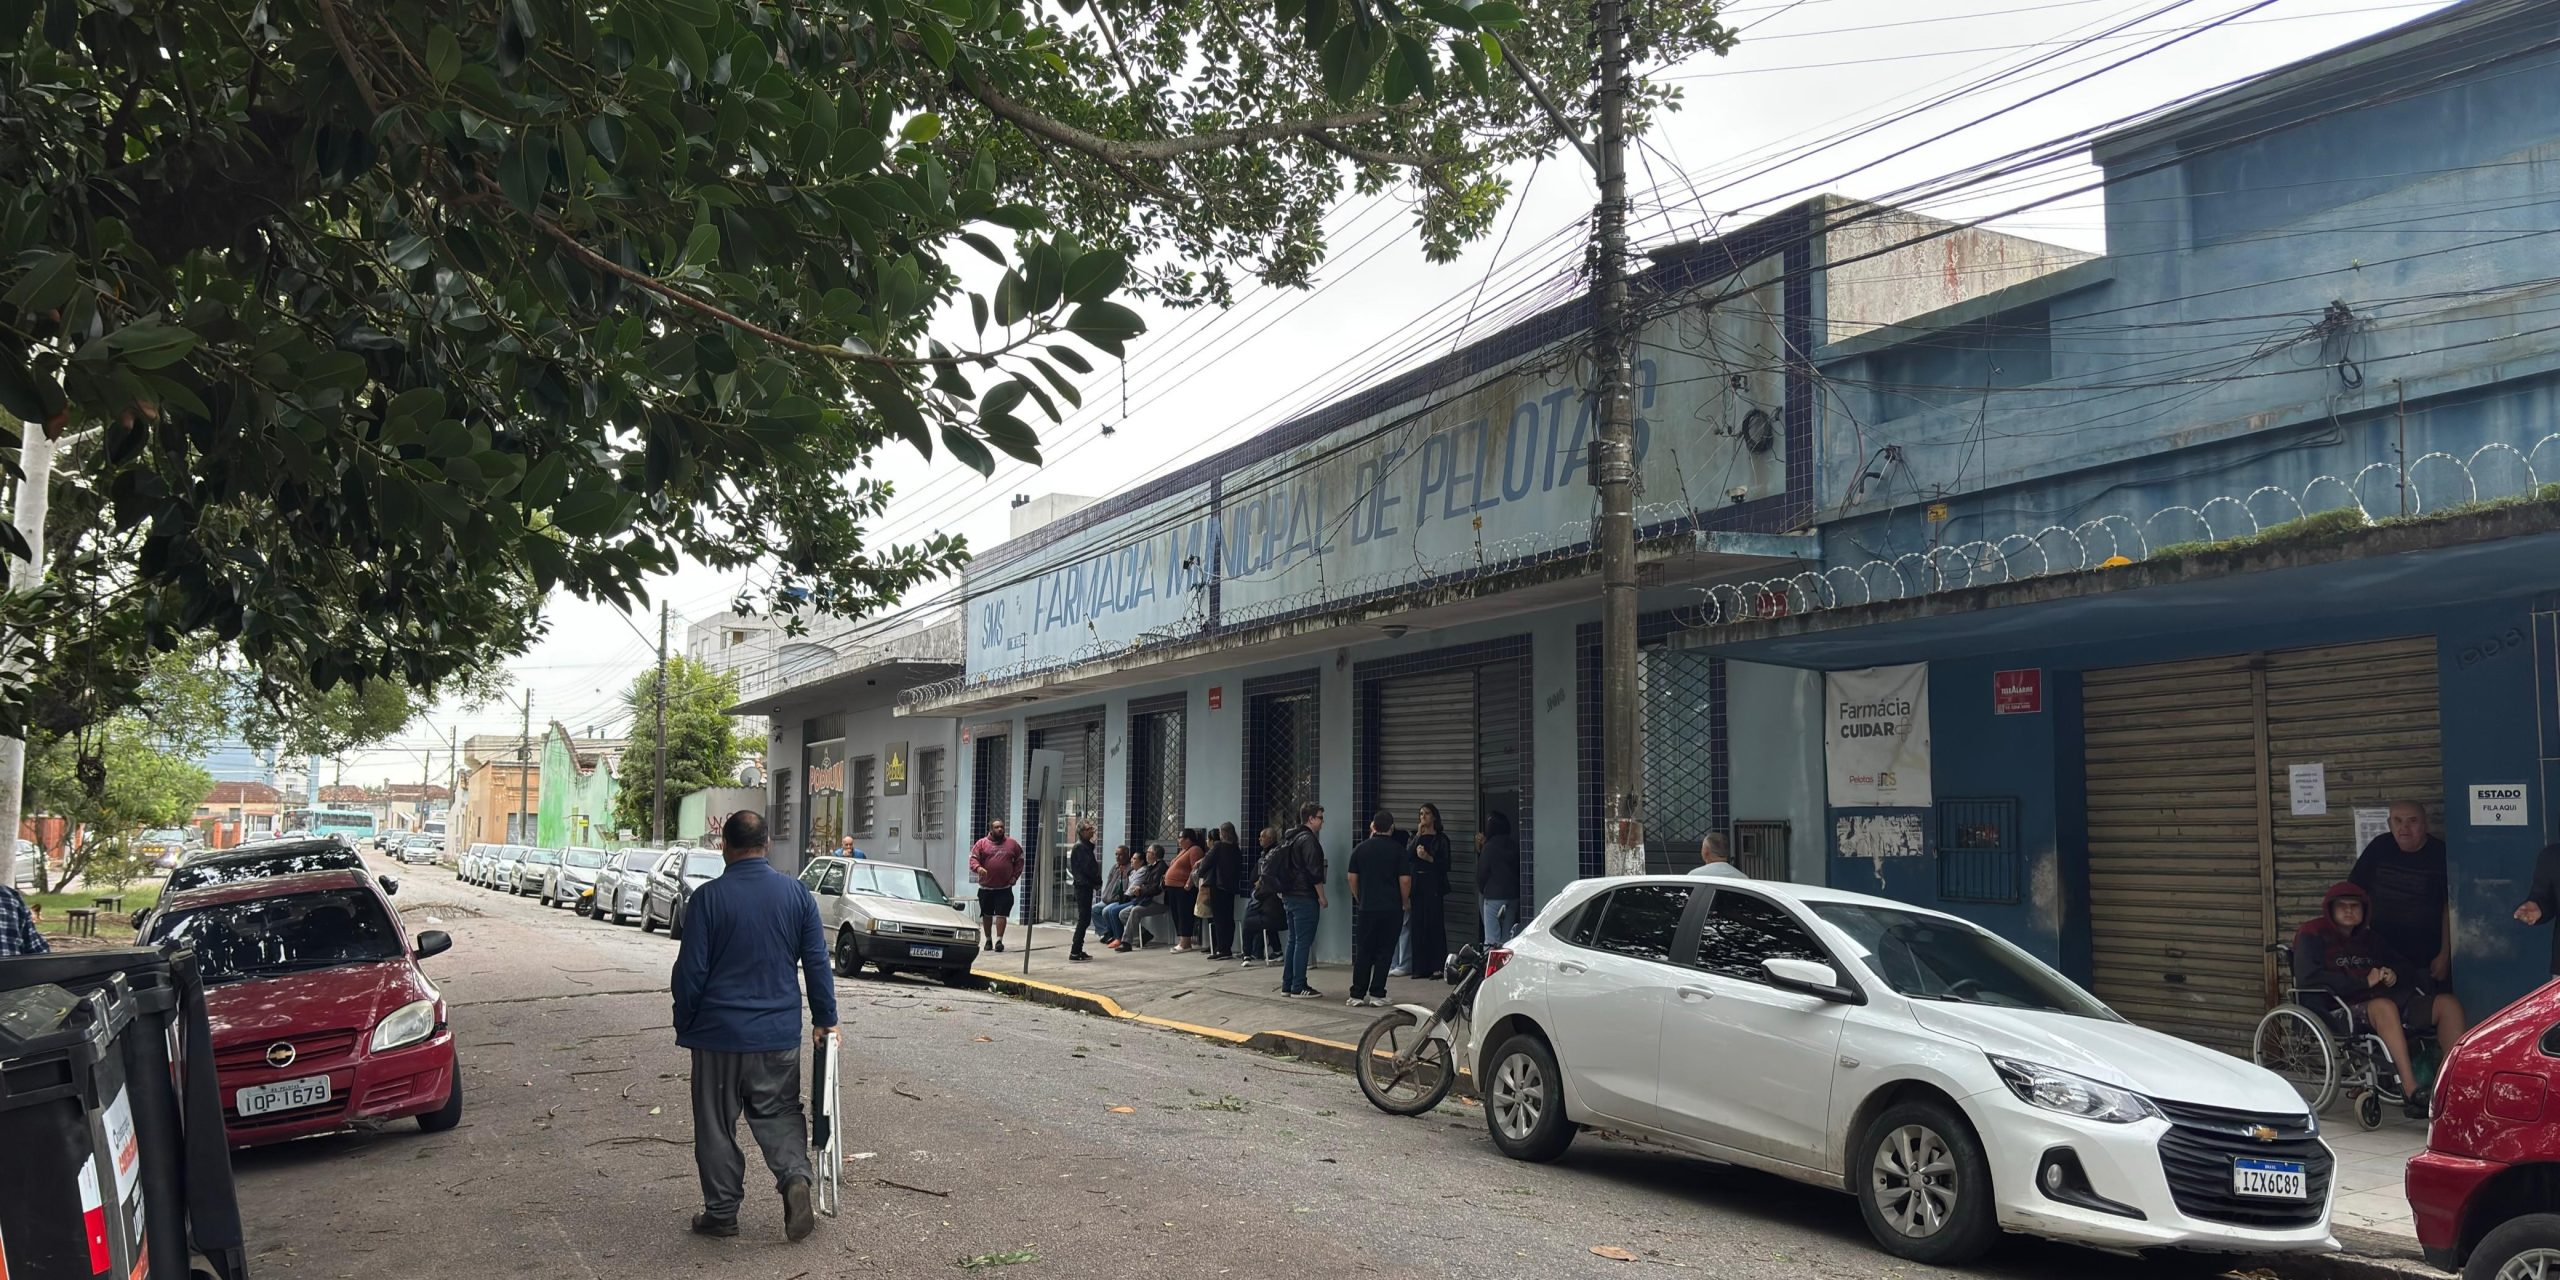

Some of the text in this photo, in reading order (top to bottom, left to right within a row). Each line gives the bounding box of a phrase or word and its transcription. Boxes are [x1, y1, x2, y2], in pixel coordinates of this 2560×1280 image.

[1166, 477, 1335, 599] MUNICIPAL
[1352, 448, 1404, 545] DE
[982, 599, 1006, 651] SMS
[1839, 697, 1911, 720] Farmácia
[1840, 722, 1895, 739] CUIDAR
[808, 760, 844, 796] PODIUM
[1849, 775, 1874, 785] Pelotas
[2477, 789, 2521, 800] ESTADO
[2483, 804, 2517, 812] FILA AQUI
[2243, 1171, 2299, 1195] IZX6C89
